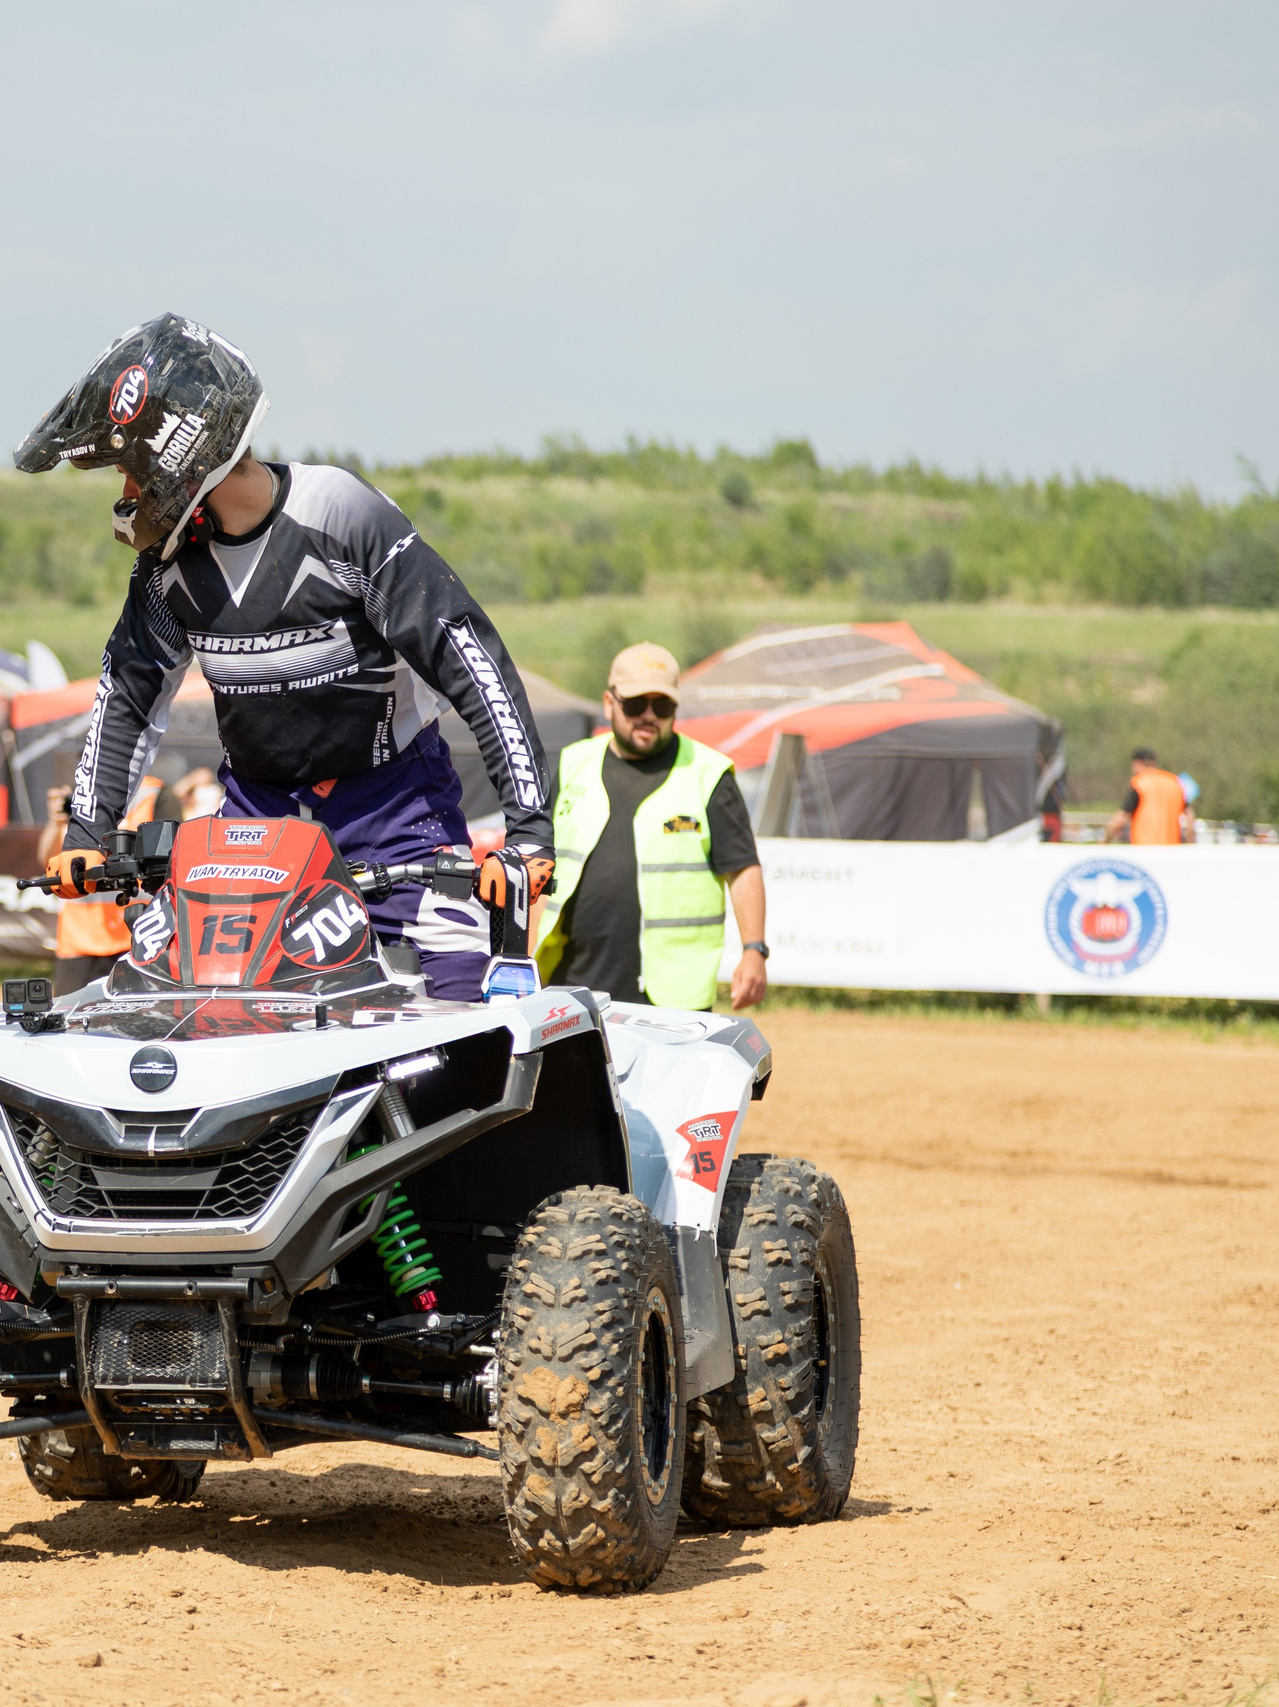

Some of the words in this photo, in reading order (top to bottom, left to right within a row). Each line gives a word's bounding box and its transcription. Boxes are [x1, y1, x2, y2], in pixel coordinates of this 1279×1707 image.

[115, 370, 145, 416] 704
[59, 446, 89, 460] TRYASOV
[158, 413, 207, 473] GORILLA
[180, 447, 197, 471] ENERGY
[188, 625, 330, 652] SHARMAX
[212, 683, 282, 694] ENTURES
[288, 663, 359, 690] AWAITS
[381, 696, 393, 744] MOTION
[449, 625, 541, 809] SHARMAX
[373, 721, 384, 767] EEDOM
[225, 830, 267, 842] TRT
[189, 866, 219, 880] IVAN
[222, 866, 286, 882] TRYASOV
[132, 898, 172, 962] 704
[198, 914, 258, 956] 15
[291, 894, 369, 963] 704
[541, 1014, 581, 1041] SHARMAX
[688, 1124, 721, 1138] TRT
[690, 1151, 716, 1174] 15
